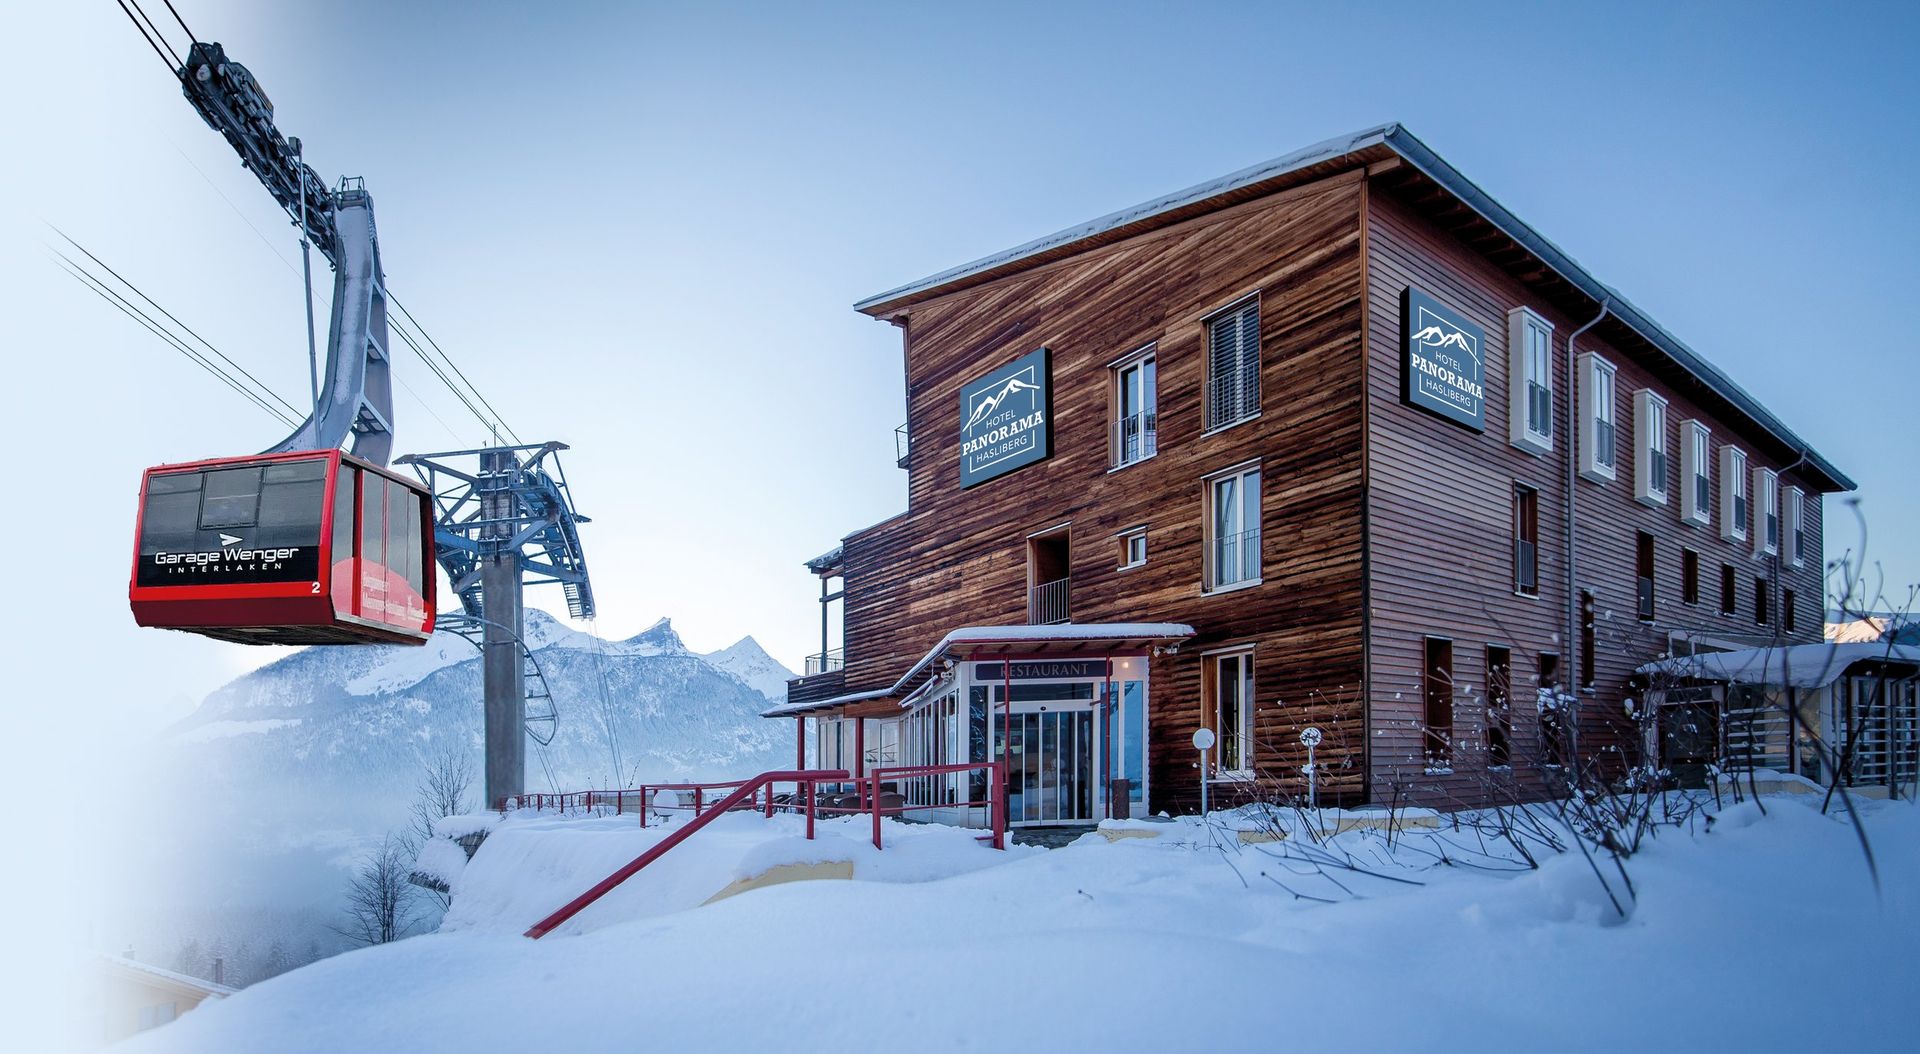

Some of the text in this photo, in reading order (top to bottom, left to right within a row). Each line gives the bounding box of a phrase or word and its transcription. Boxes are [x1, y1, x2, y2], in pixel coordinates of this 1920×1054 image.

[1435, 350, 1462, 373] HOTEL
[1411, 352, 1484, 400] PANORAMA
[1426, 380, 1471, 407] HASLIBERG
[985, 409, 1016, 429] HOTEL
[962, 410, 1044, 456] PANORAMA
[976, 435, 1028, 463] HASLIBERG
[155, 547, 299, 566] Garage Wenger
[169, 562, 282, 574] INTERLAKEN
[311, 581, 321, 593] 2
[1000, 663, 1089, 678] RESTAURANT
